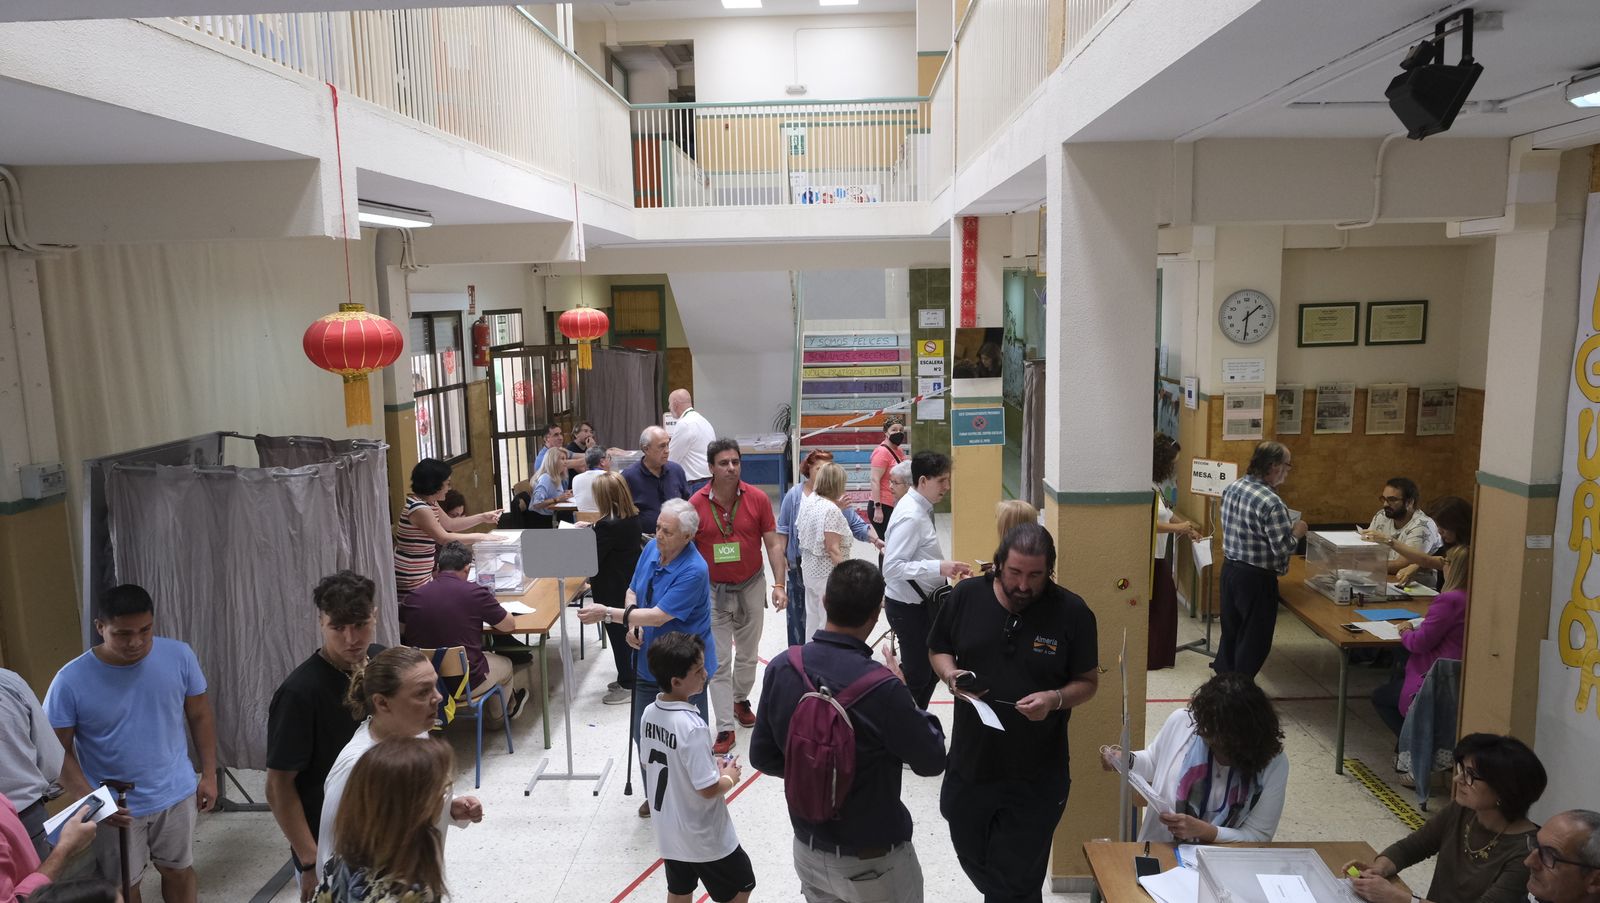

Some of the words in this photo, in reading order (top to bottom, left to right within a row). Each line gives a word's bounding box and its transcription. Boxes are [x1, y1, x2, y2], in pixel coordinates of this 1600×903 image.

[819, 338, 848, 346] SOMOS
[852, 336, 890, 345] FELICES
[1193, 470, 1212, 479] MESA
[1219, 472, 1226, 480] B
[718, 545, 735, 555] VOX
[645, 722, 677, 750] RINERO
[648, 748, 669, 812] 7
